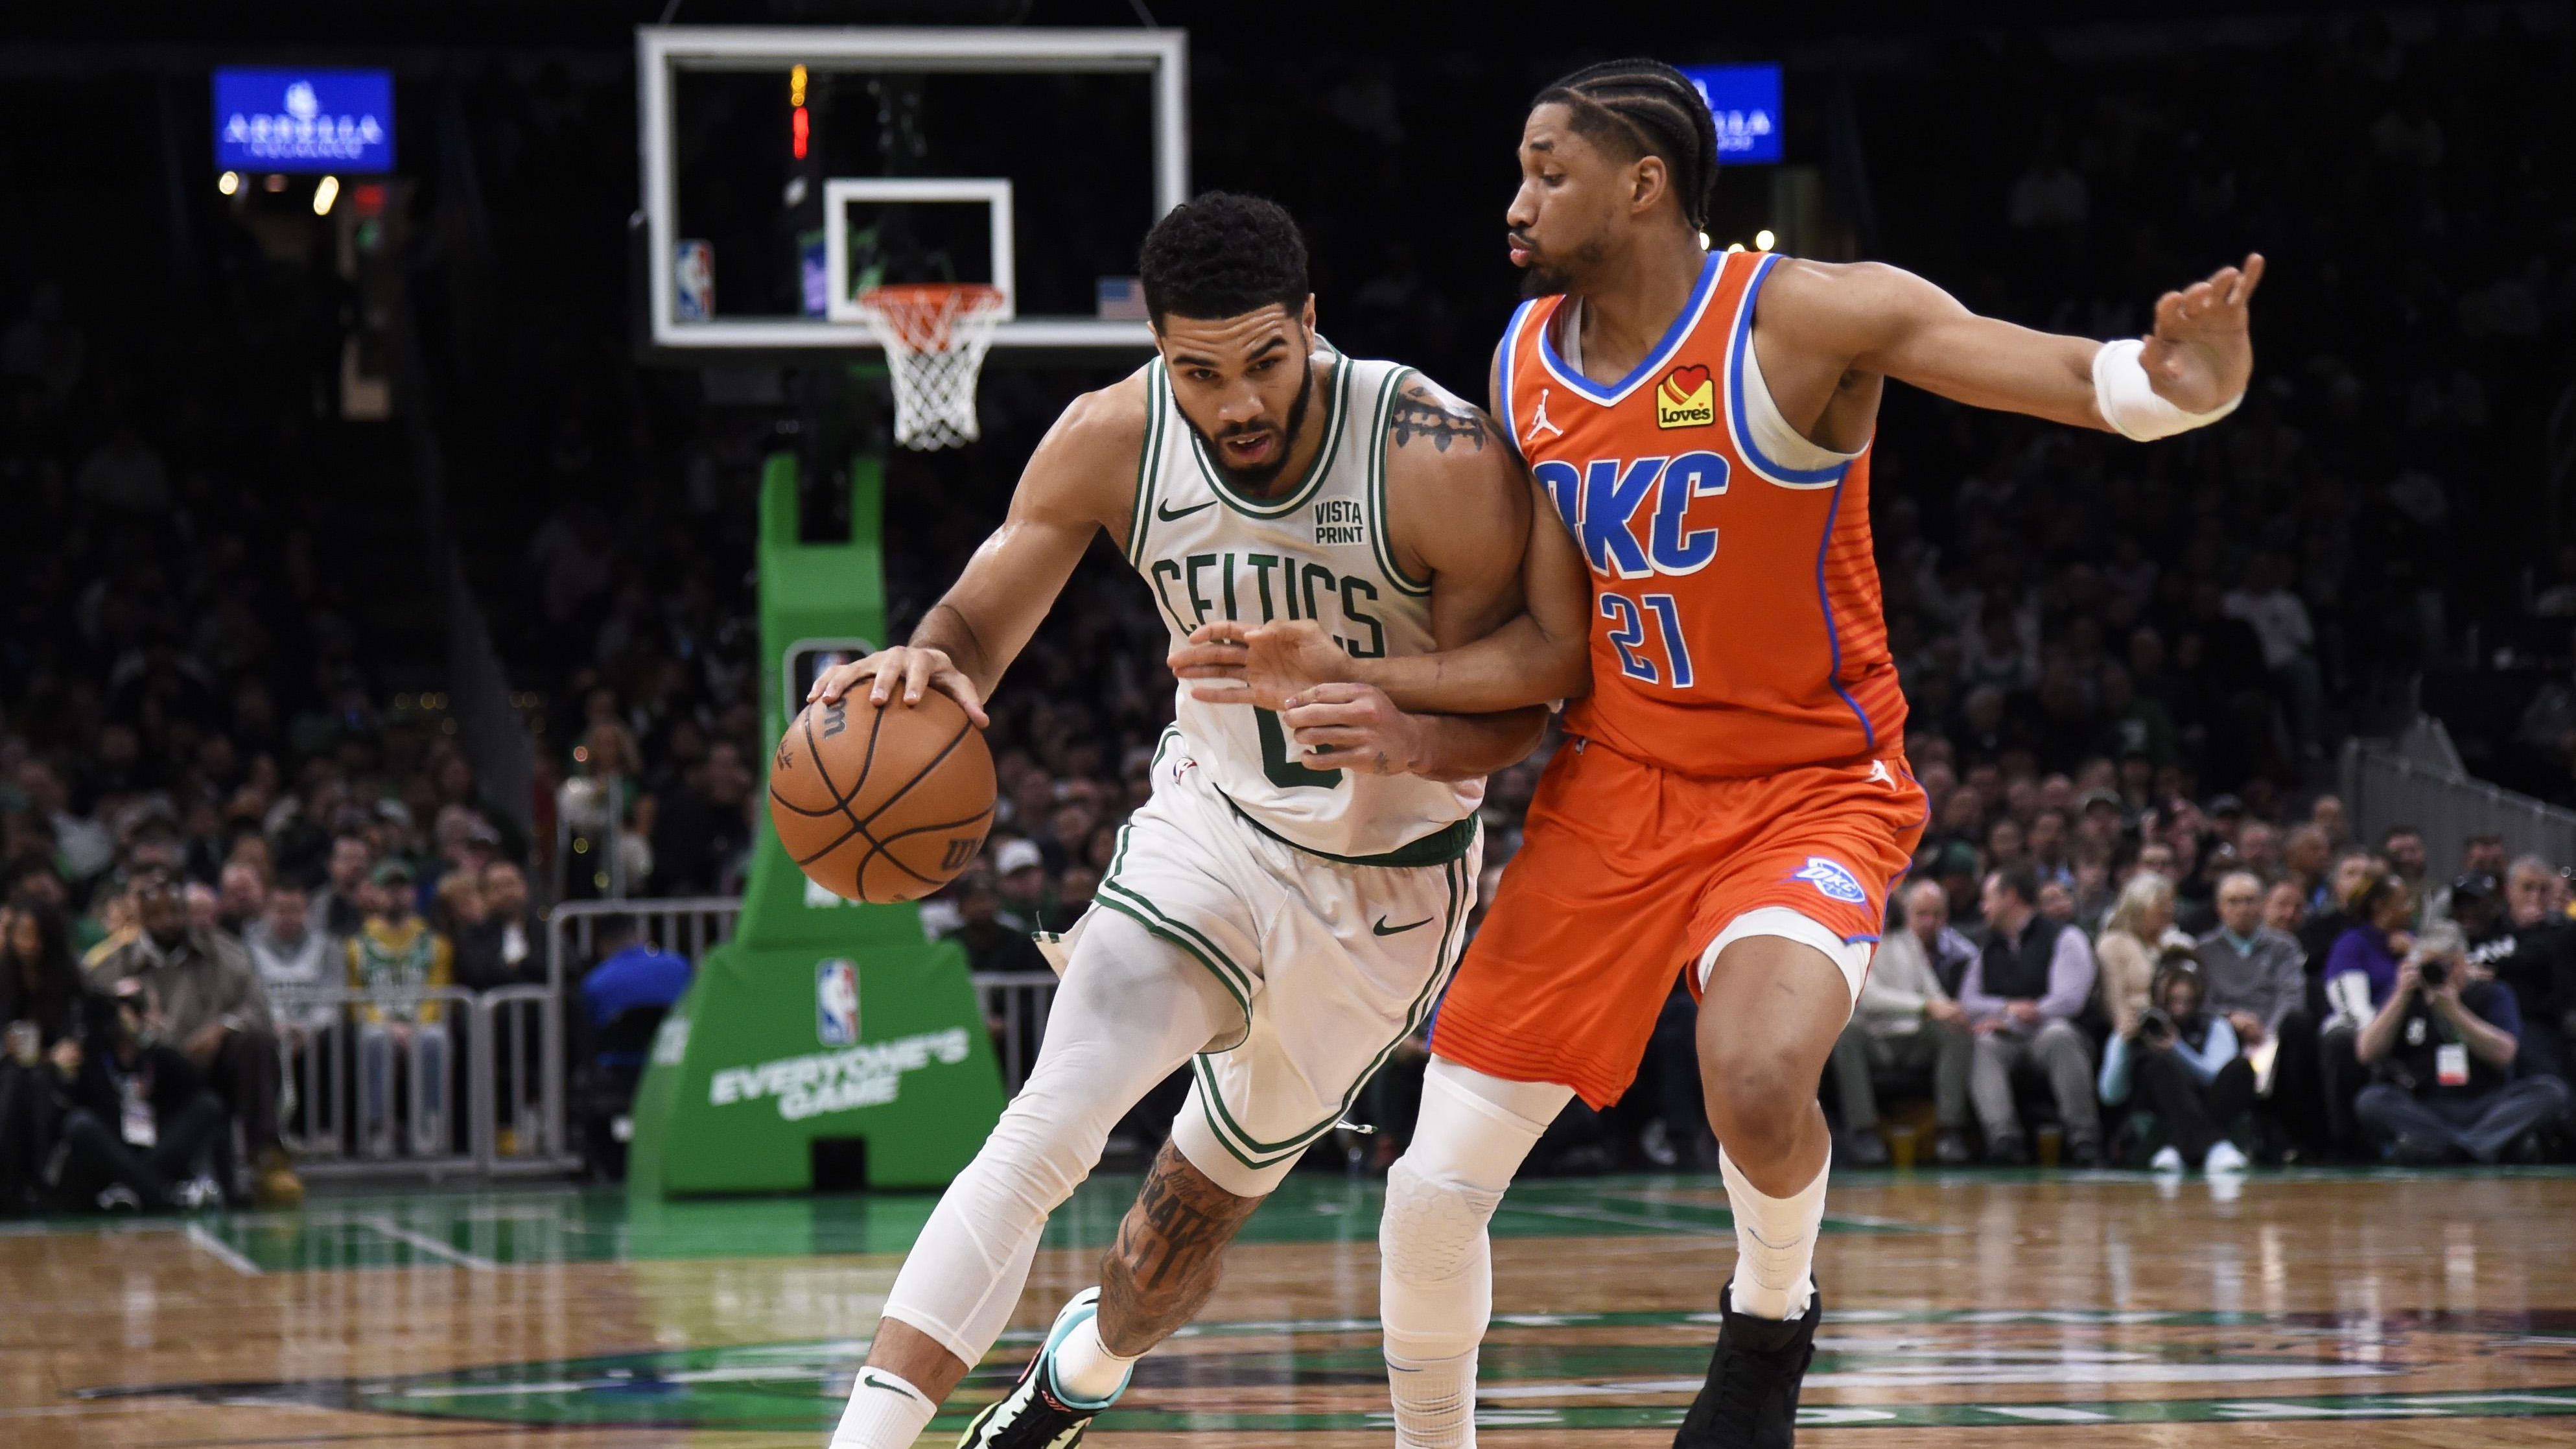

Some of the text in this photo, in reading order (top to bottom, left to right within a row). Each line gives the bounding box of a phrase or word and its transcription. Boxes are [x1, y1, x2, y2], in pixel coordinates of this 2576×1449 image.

[1315, 500, 1363, 526] VISTA
[1315, 526, 1363, 545] PRINT
[1599, 593, 1694, 689] 21
[708, 1026, 970, 1106] EVERYONE'S
[778, 1070, 901, 1122] GAME
